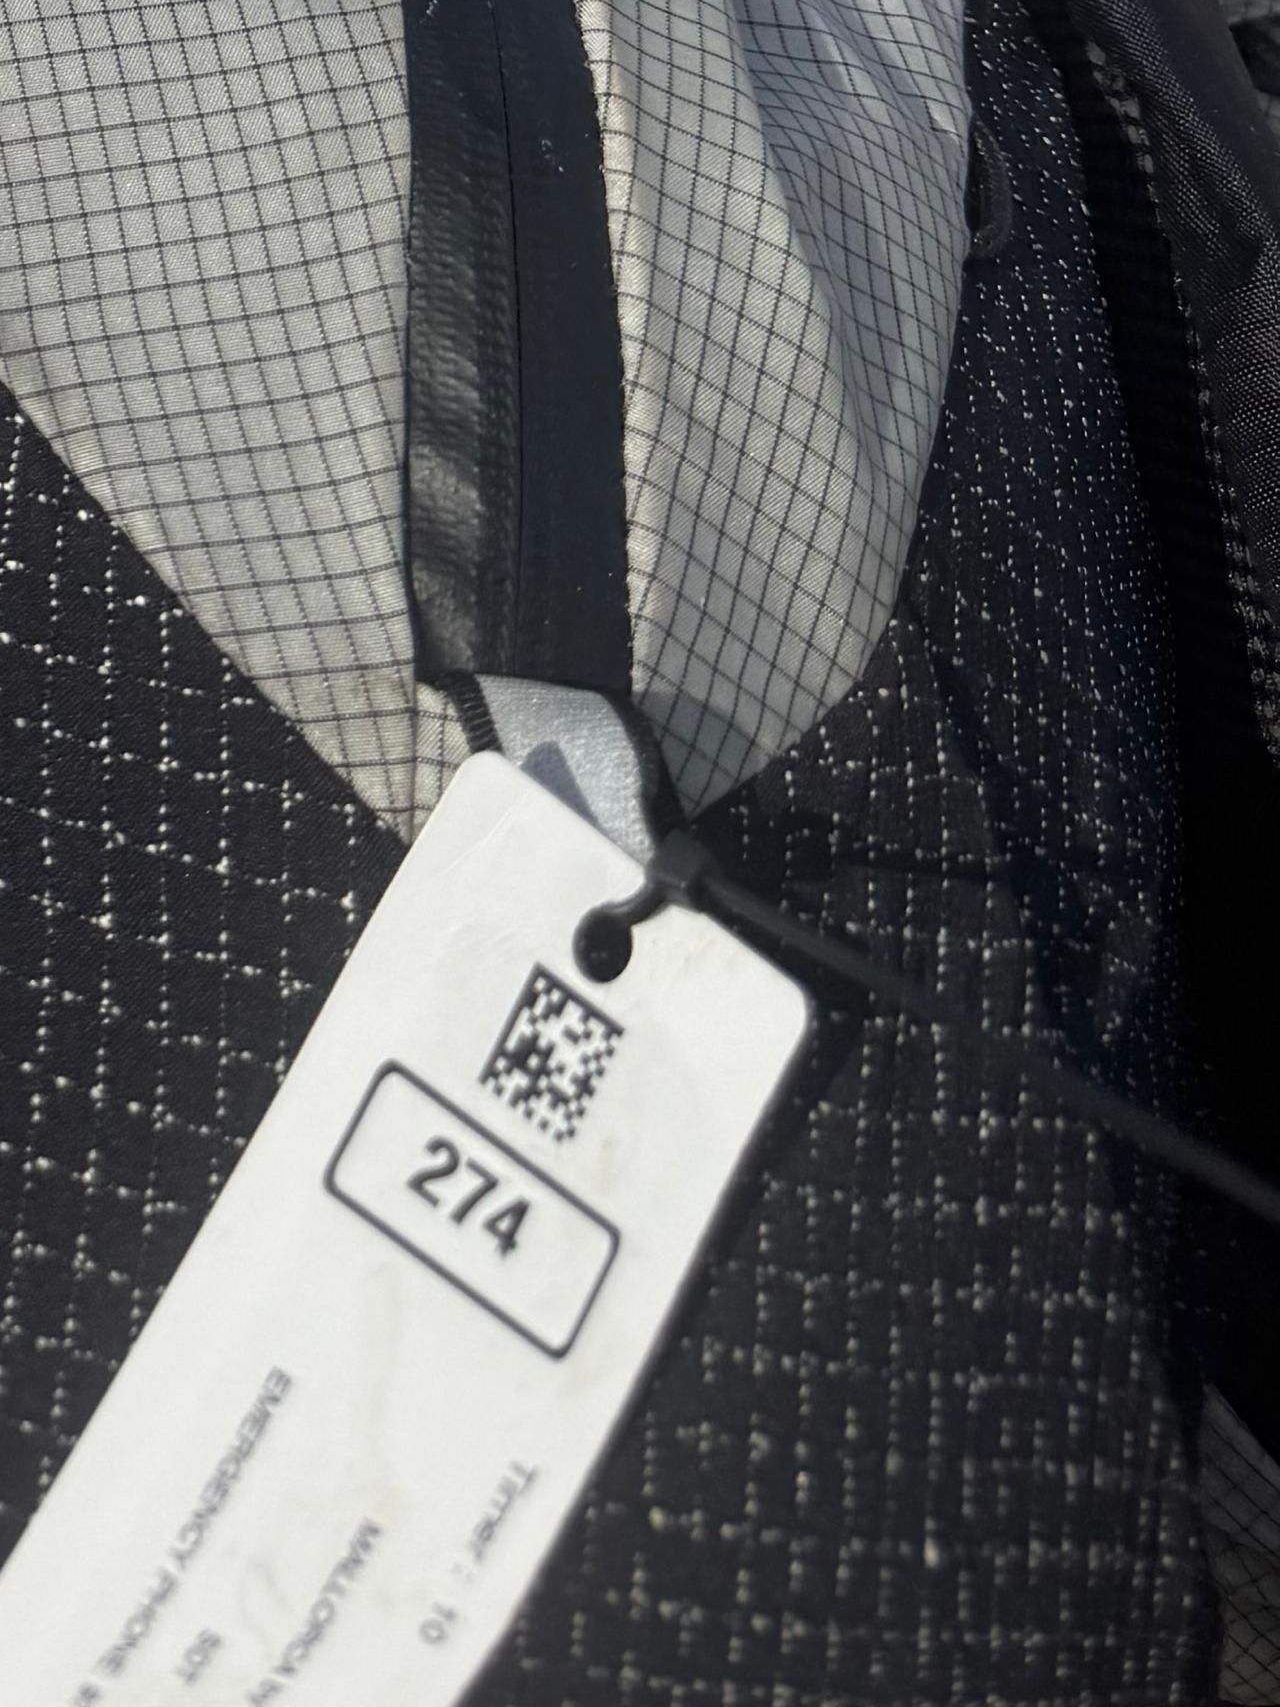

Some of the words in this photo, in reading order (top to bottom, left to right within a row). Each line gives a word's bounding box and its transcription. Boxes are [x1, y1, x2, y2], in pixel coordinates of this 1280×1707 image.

[407, 1136, 530, 1257] 274
[171, 1366, 293, 1571] EMERGENCY
[95, 1567, 179, 1677] PHONE
[271, 1516, 383, 1677] MALLORCA
